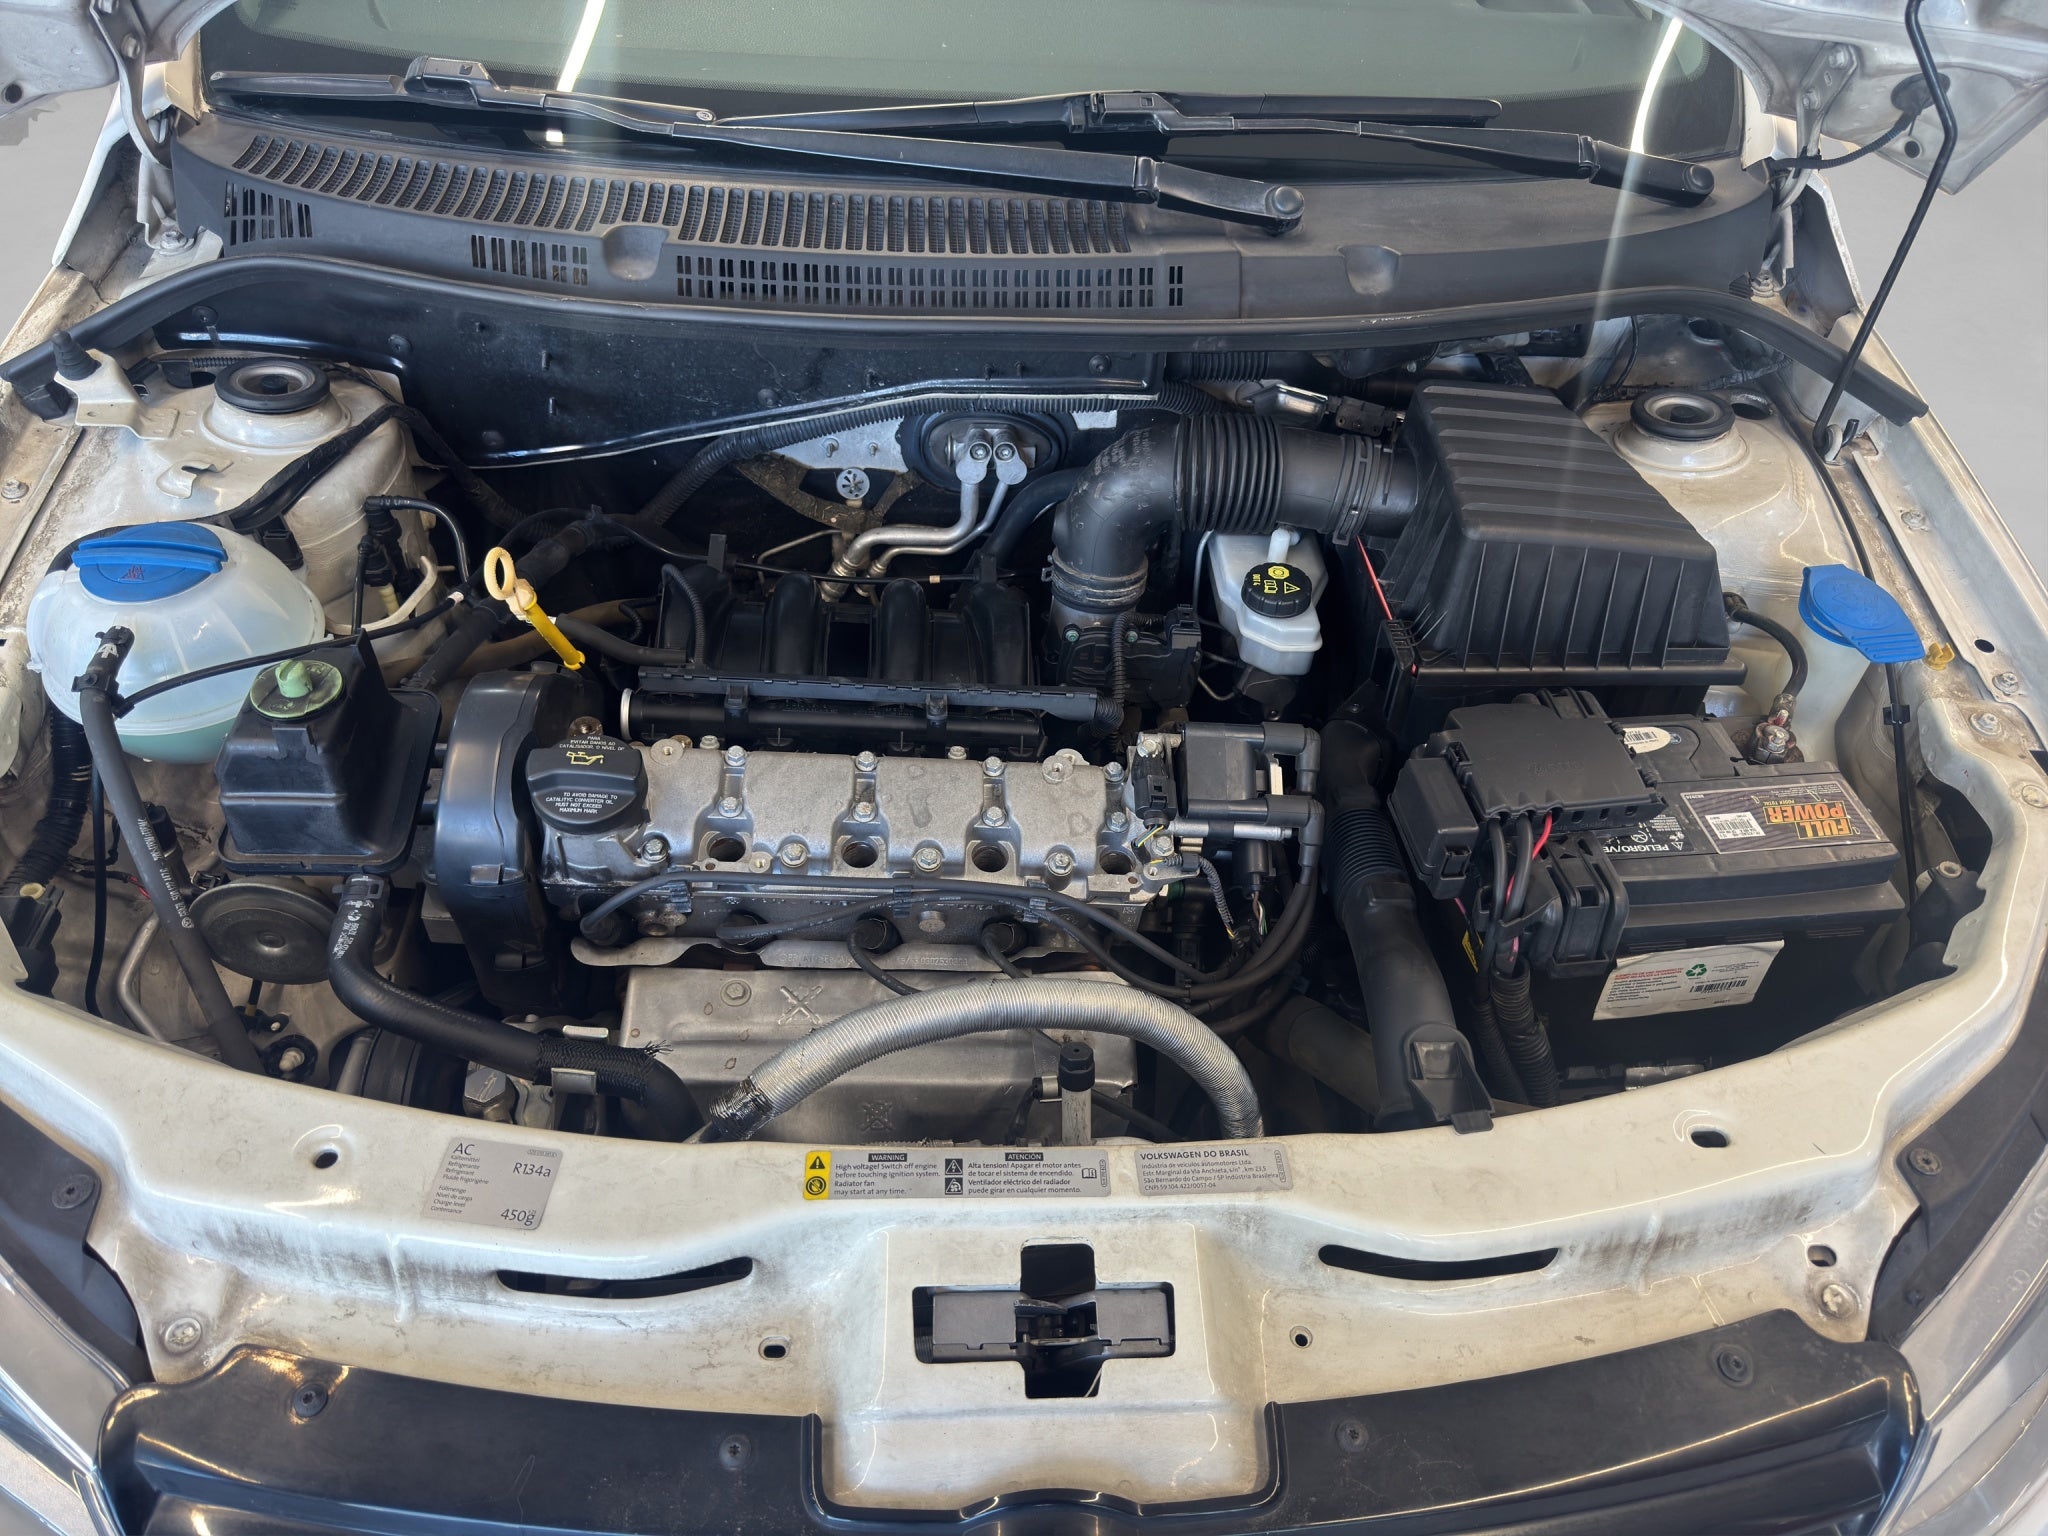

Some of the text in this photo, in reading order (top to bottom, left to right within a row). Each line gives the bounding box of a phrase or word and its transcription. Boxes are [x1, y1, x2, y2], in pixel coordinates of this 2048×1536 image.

[1768, 802, 1844, 822] POWER
[1800, 818, 1850, 838] FULL
[453, 1143, 475, 1156] AC
[1140, 1151, 1201, 1160] VOLKSWAGEN
[1220, 1149, 1248, 1157] BRASIL
[445, 1168, 474, 1176] Refrigerant
[513, 1162, 551, 1178] R134a
[836, 1163, 852, 1171] High
[853, 1163, 880, 1171] voltage!
[858, 1171, 888, 1179] touching
[433, 1199, 450, 1207] Charge
[500, 1208, 536, 1225] 450g
